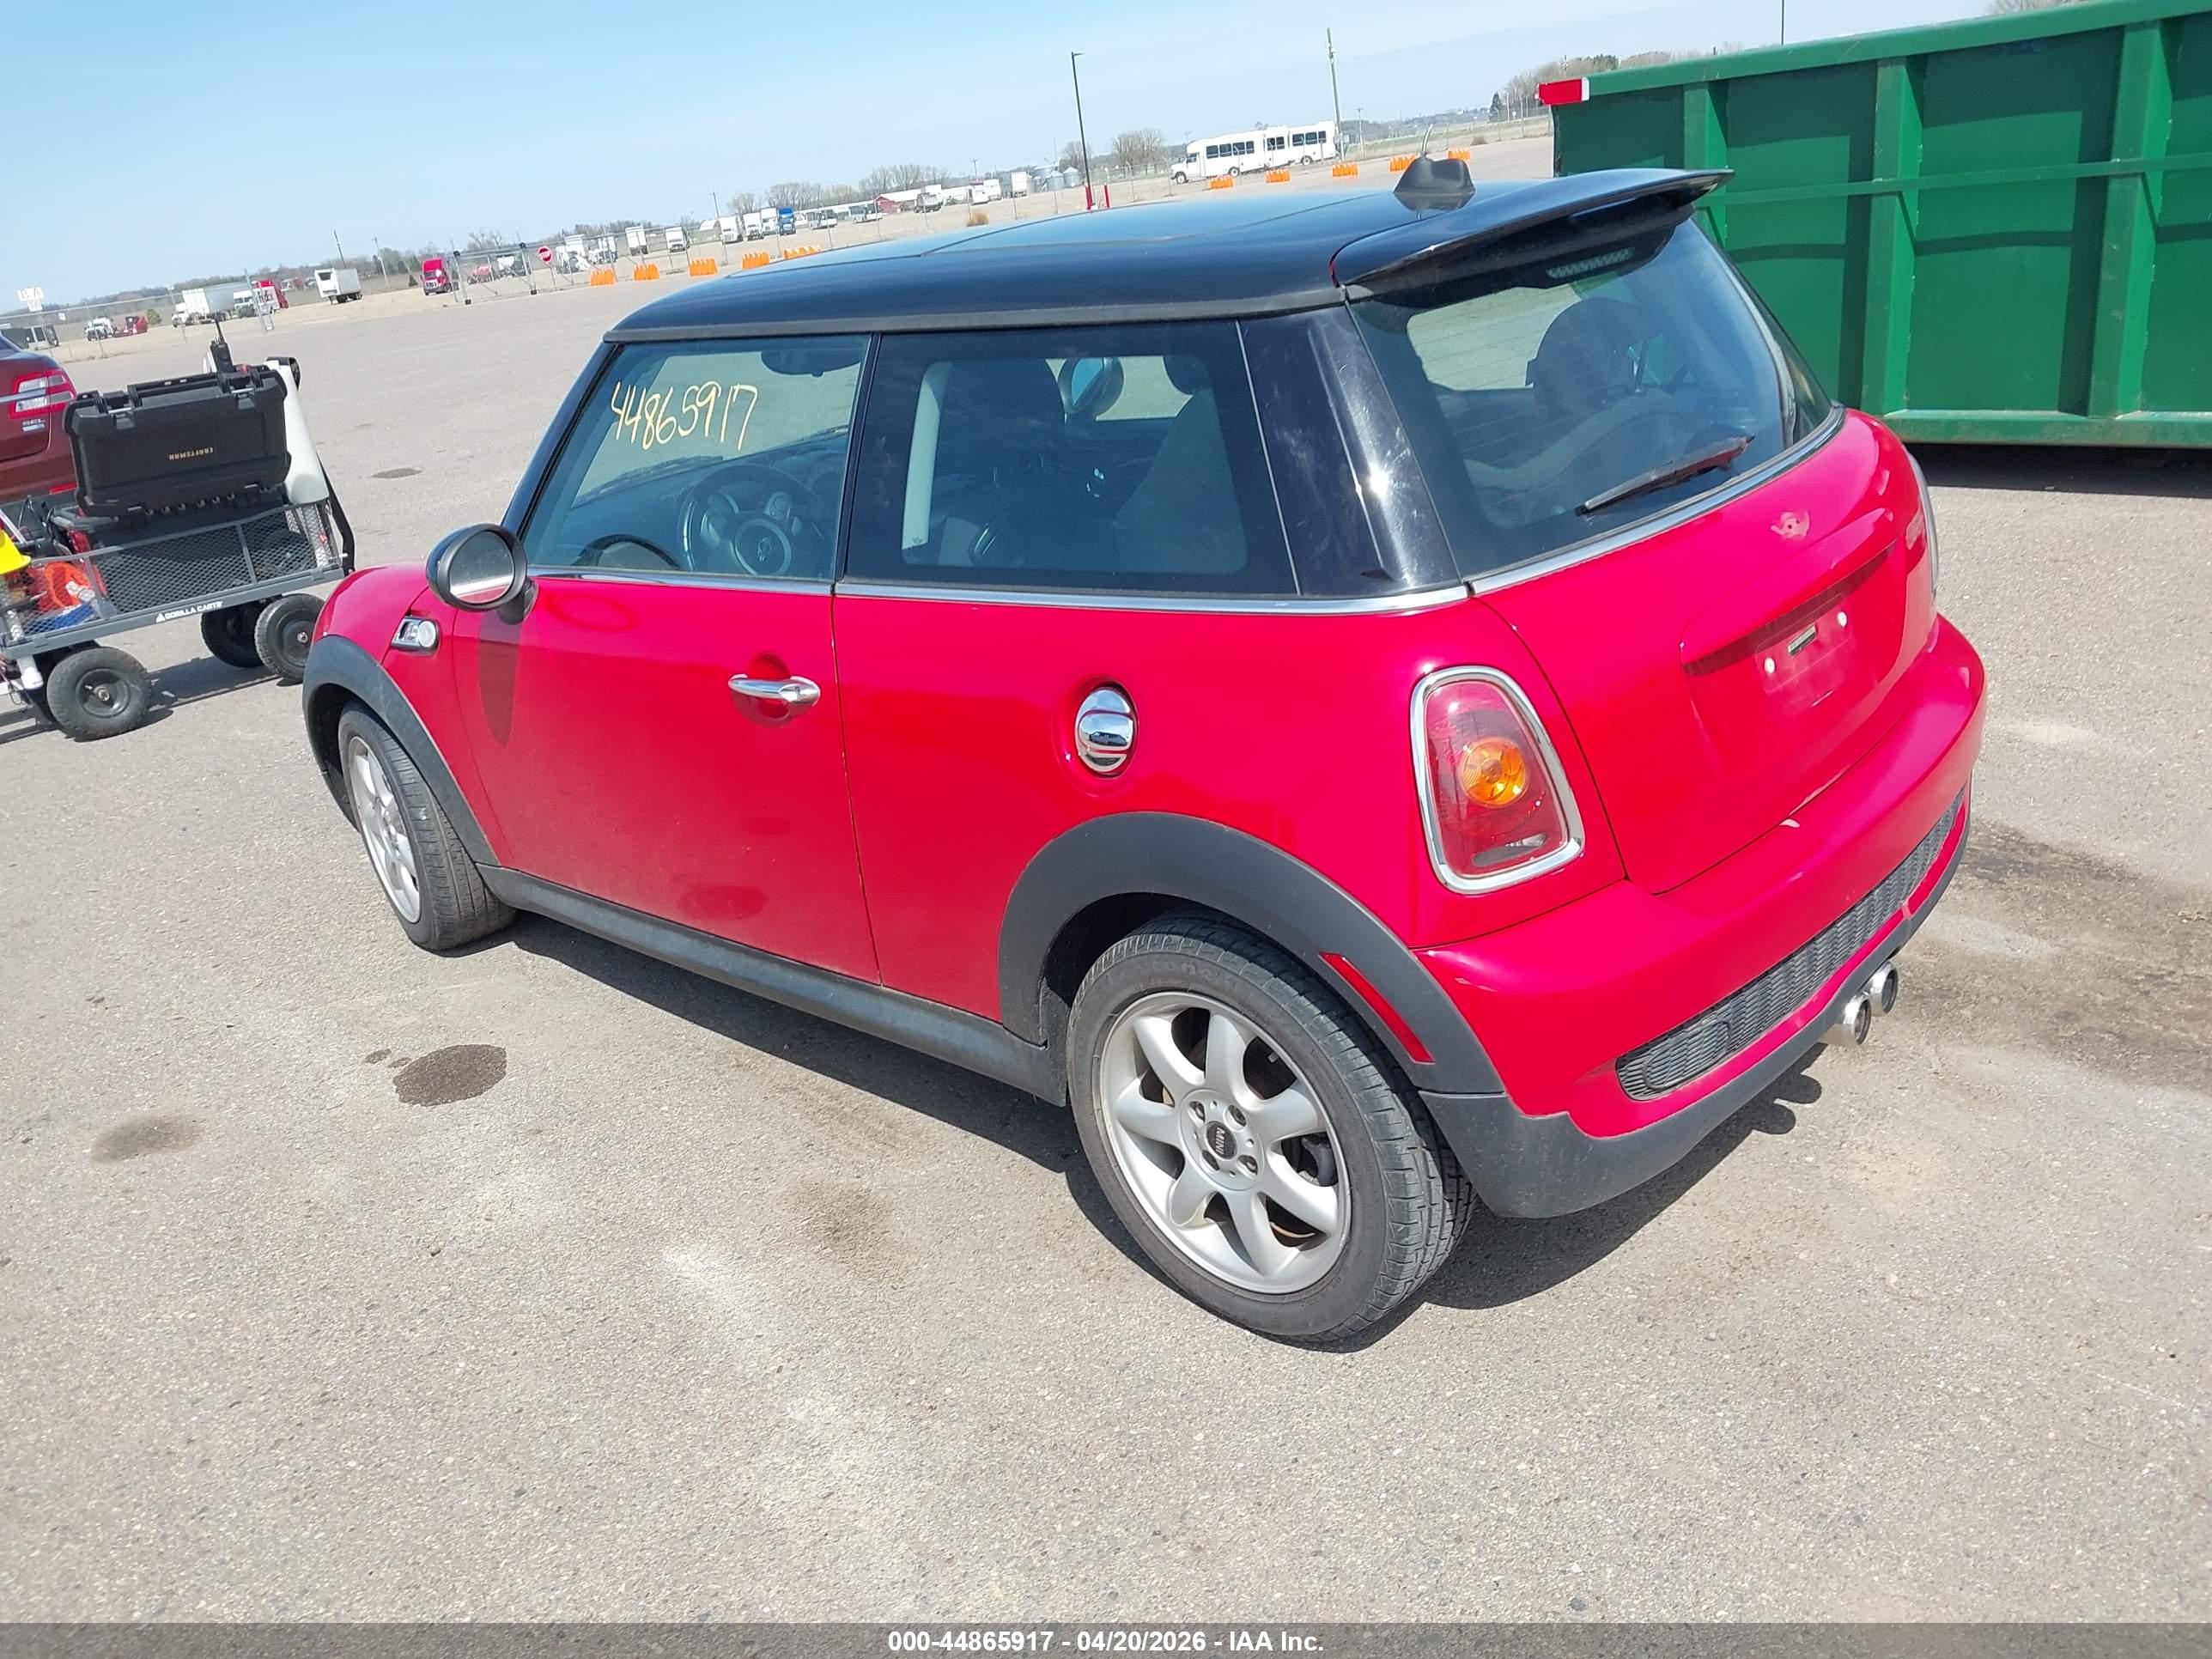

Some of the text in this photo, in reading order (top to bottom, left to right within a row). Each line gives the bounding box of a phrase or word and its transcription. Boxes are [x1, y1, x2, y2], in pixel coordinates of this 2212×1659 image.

[611, 380, 758, 452] 44865917
[168, 447, 214, 460] CRAFTSMAN
[164, 606, 197, 619] GORILLA
[1215, 1127, 1225, 1155] MINI
